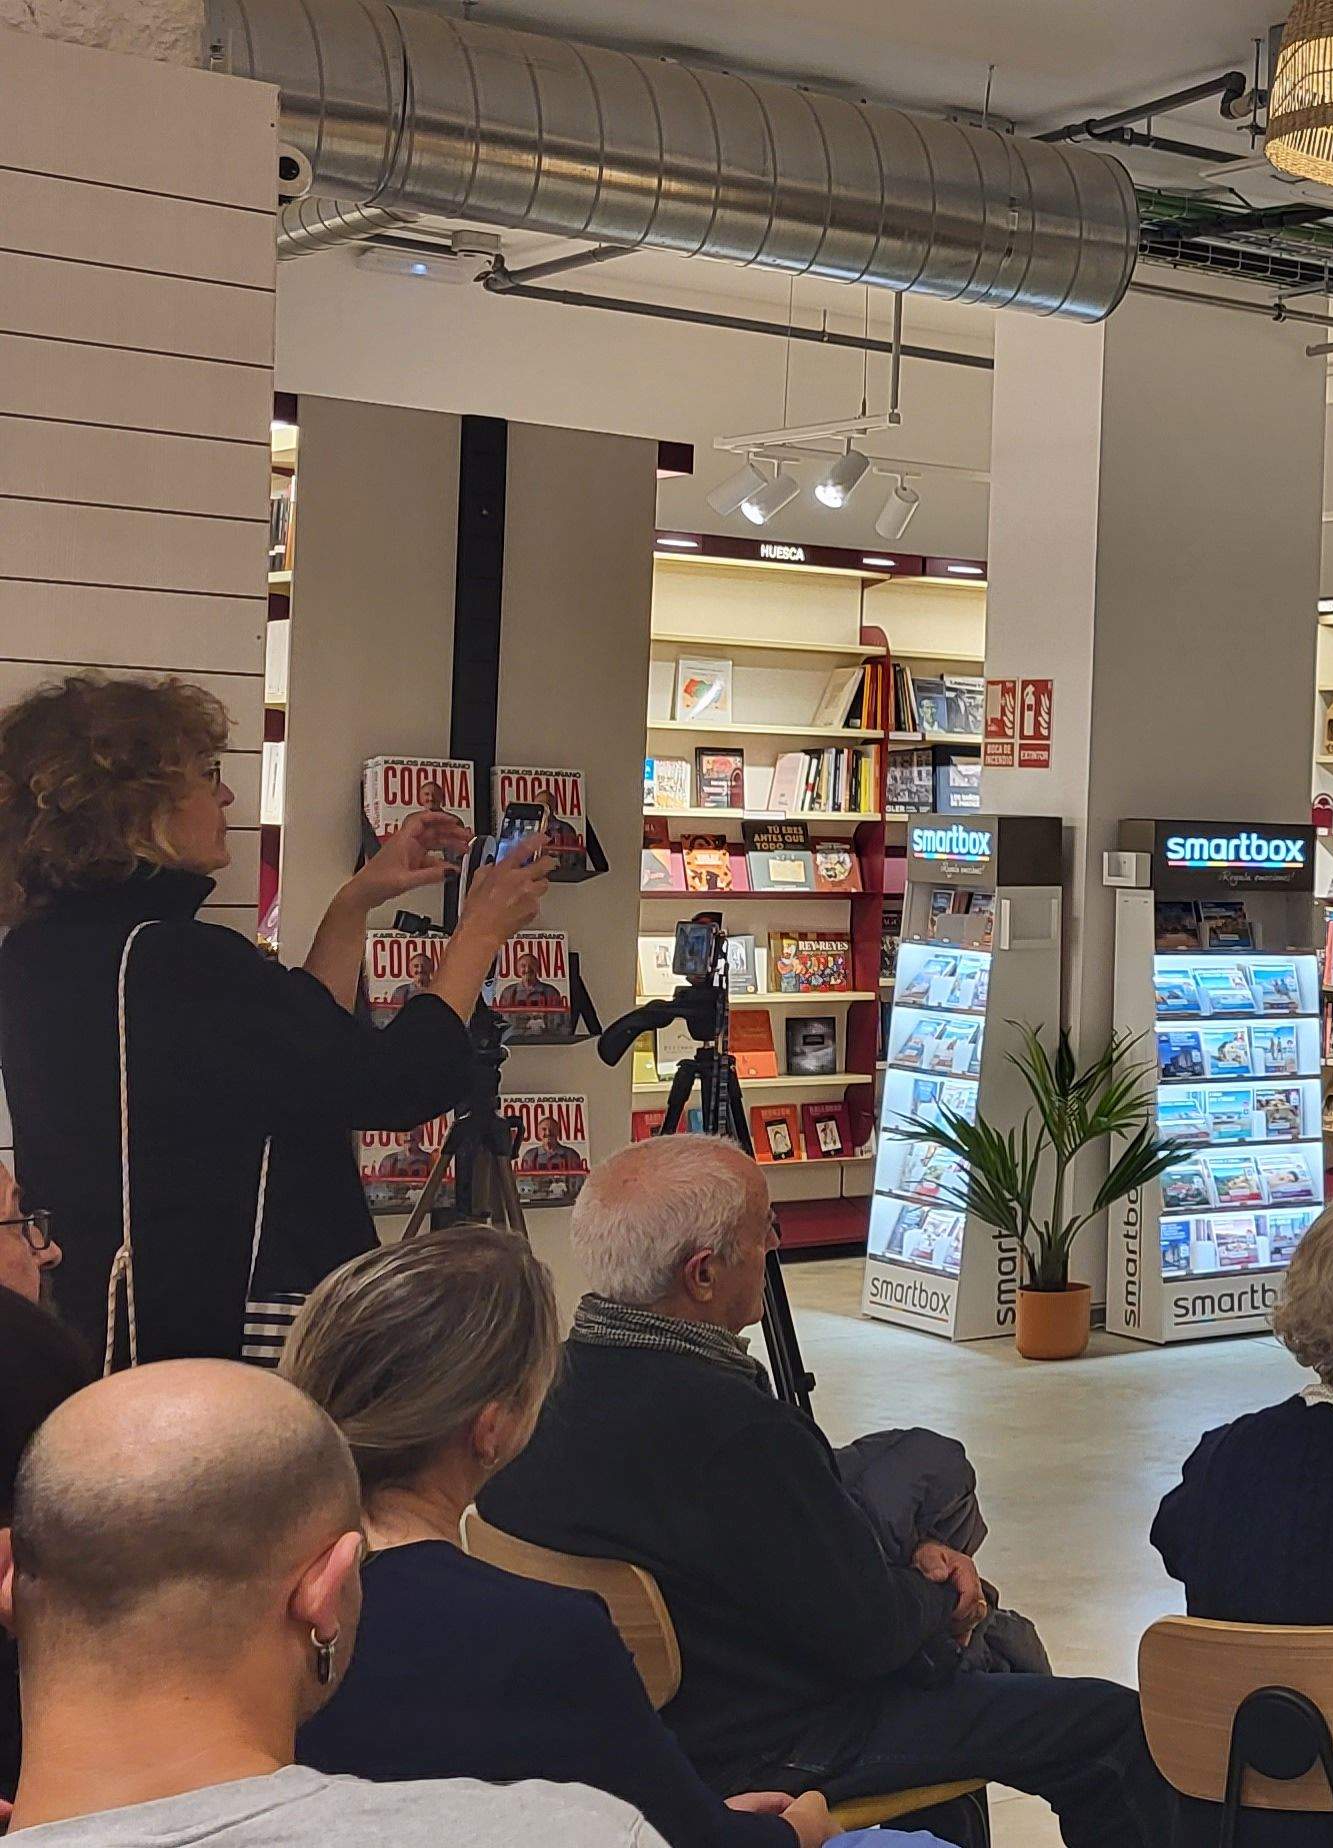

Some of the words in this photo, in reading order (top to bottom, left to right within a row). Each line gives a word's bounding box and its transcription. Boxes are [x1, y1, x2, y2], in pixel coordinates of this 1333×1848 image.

[761, 544, 806, 561] HUESCA
[987, 744, 1002, 754] BOCA
[1003, 744, 1011, 754] DE
[985, 755, 1013, 765] INCENDIO
[1020, 750, 1049, 760] EXTINTOR
[384, 759, 418, 767] KARLOS
[419, 760, 471, 770] ARGUIÑANO
[533, 770, 582, 778] ARGUIÑANO
[767, 824, 780, 834] TÚ
[782, 825, 804, 835] ERES
[754, 833, 783, 843] ANTES
[785, 834, 805, 844] QUE
[913, 825, 992, 855] smartbox
[755, 842, 785, 851] TODO
[1166, 832, 1305, 862] smartbox
[819, 940, 849, 951] REYES
[500, 940, 567, 979] OCNA
[1123, 1187, 1140, 1329] smartbo
[992, 1226, 1016, 1326] smart
[869, 1276, 951, 1316] smartbox
[1173, 1283, 1279, 1318] smartb
